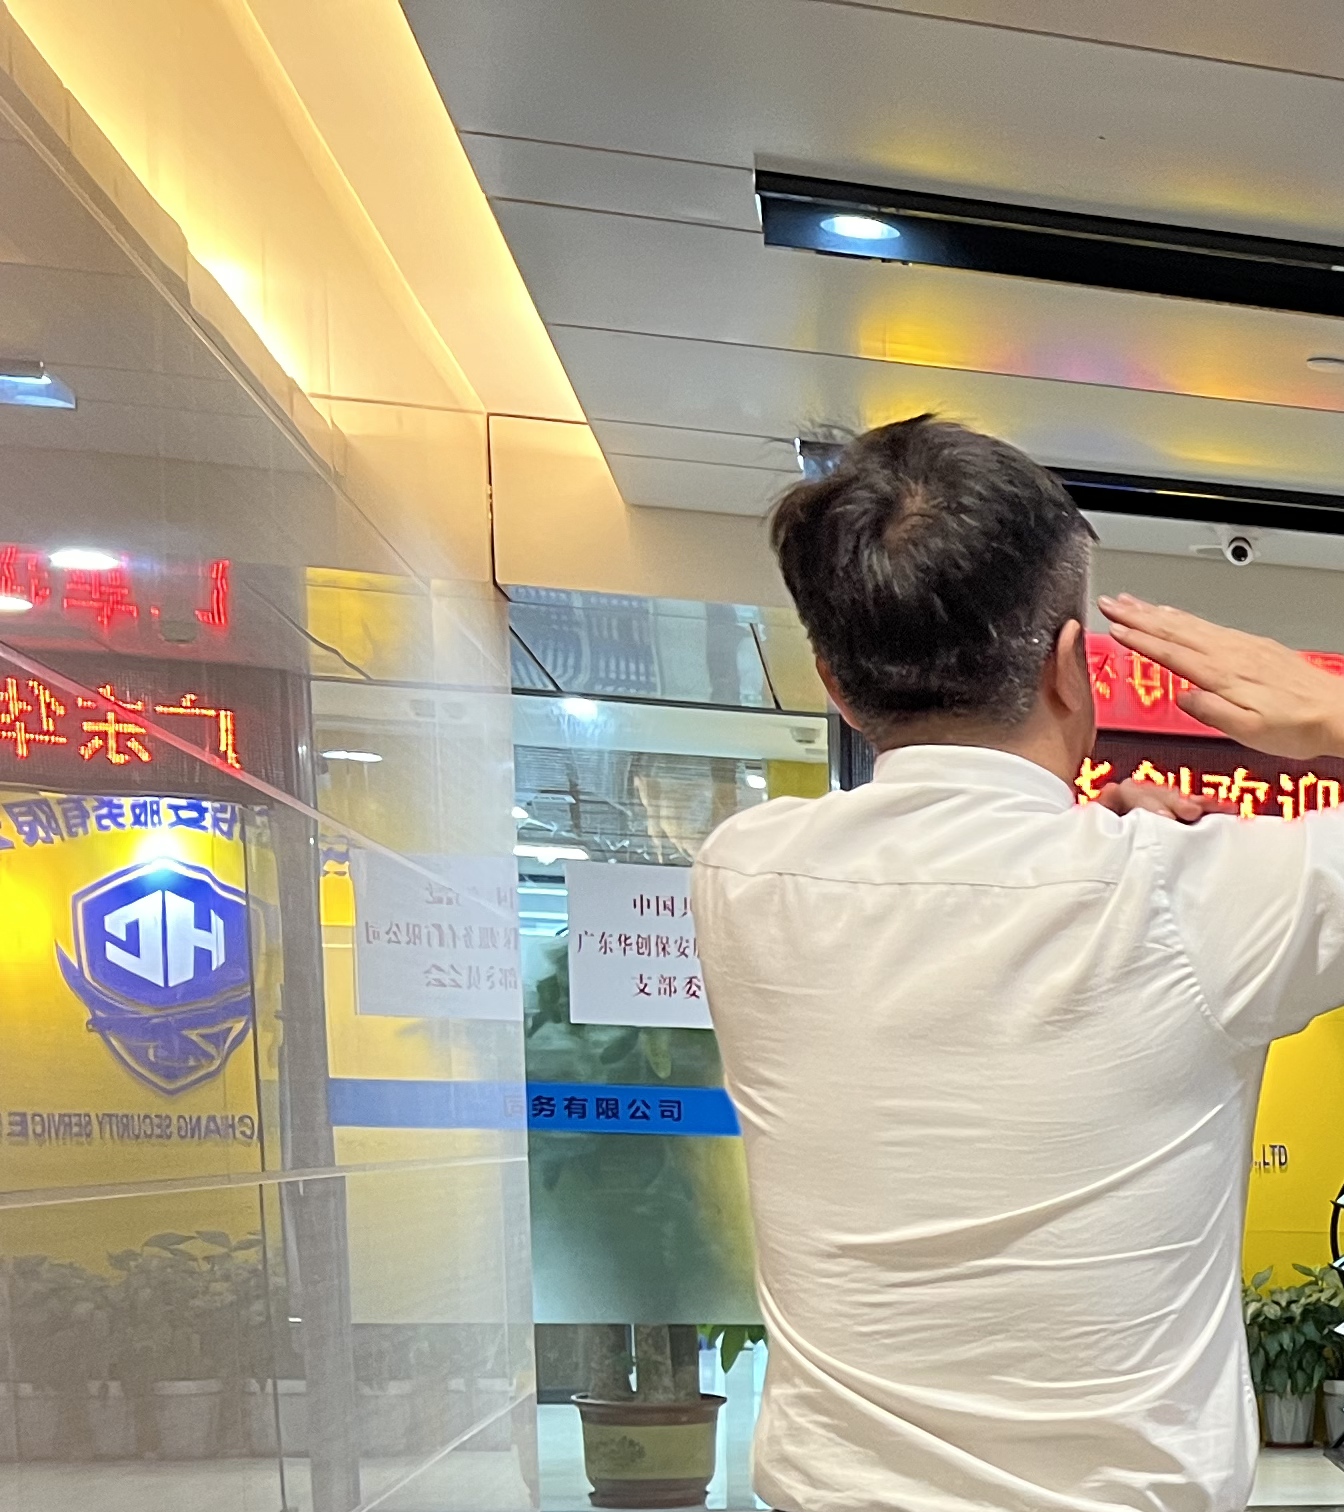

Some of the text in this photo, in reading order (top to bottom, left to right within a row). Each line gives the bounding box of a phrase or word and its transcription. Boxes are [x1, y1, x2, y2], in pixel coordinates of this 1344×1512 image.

[577, 930, 699, 959] 广东华创保安
[531, 1094, 683, 1122] 务有限公司
